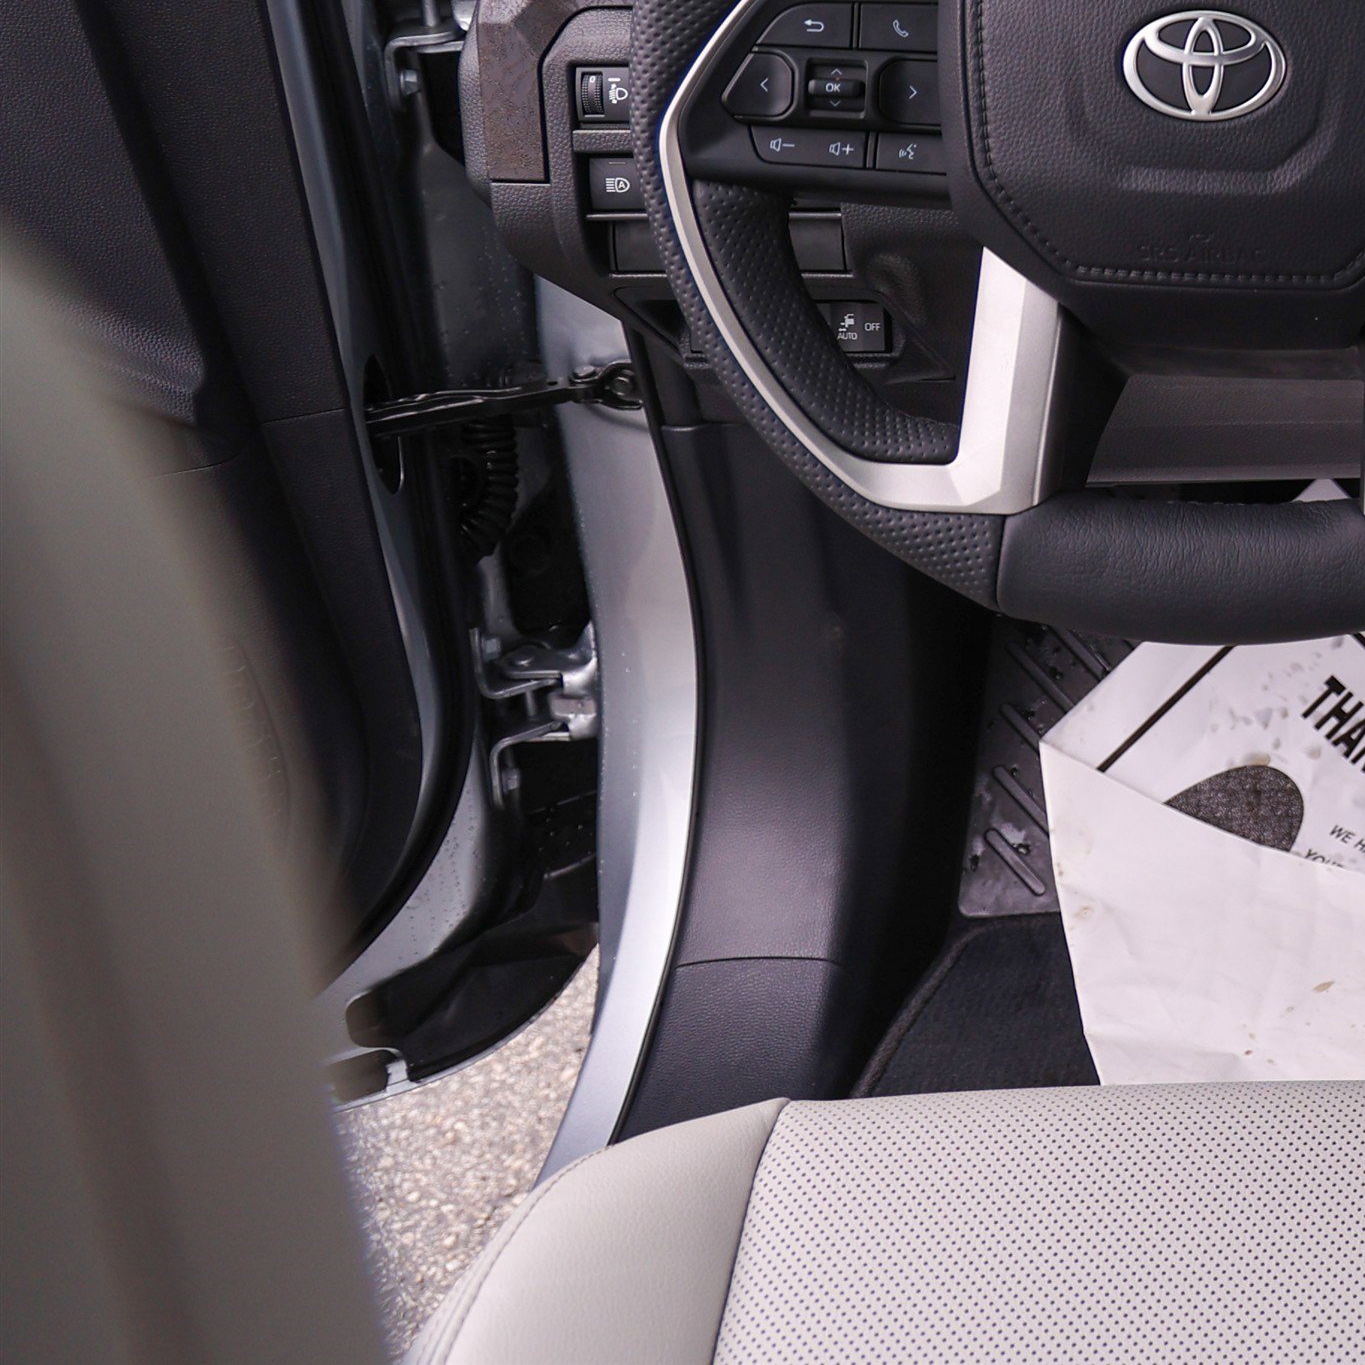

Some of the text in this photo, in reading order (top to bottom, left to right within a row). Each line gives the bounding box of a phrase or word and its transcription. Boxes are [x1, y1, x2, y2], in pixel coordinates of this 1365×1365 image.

[825, 82, 842, 93] OK
[864, 322, 881, 332] OFF
[837, 332, 858, 341] AUTO
[1329, 825, 1356, 844] WE
